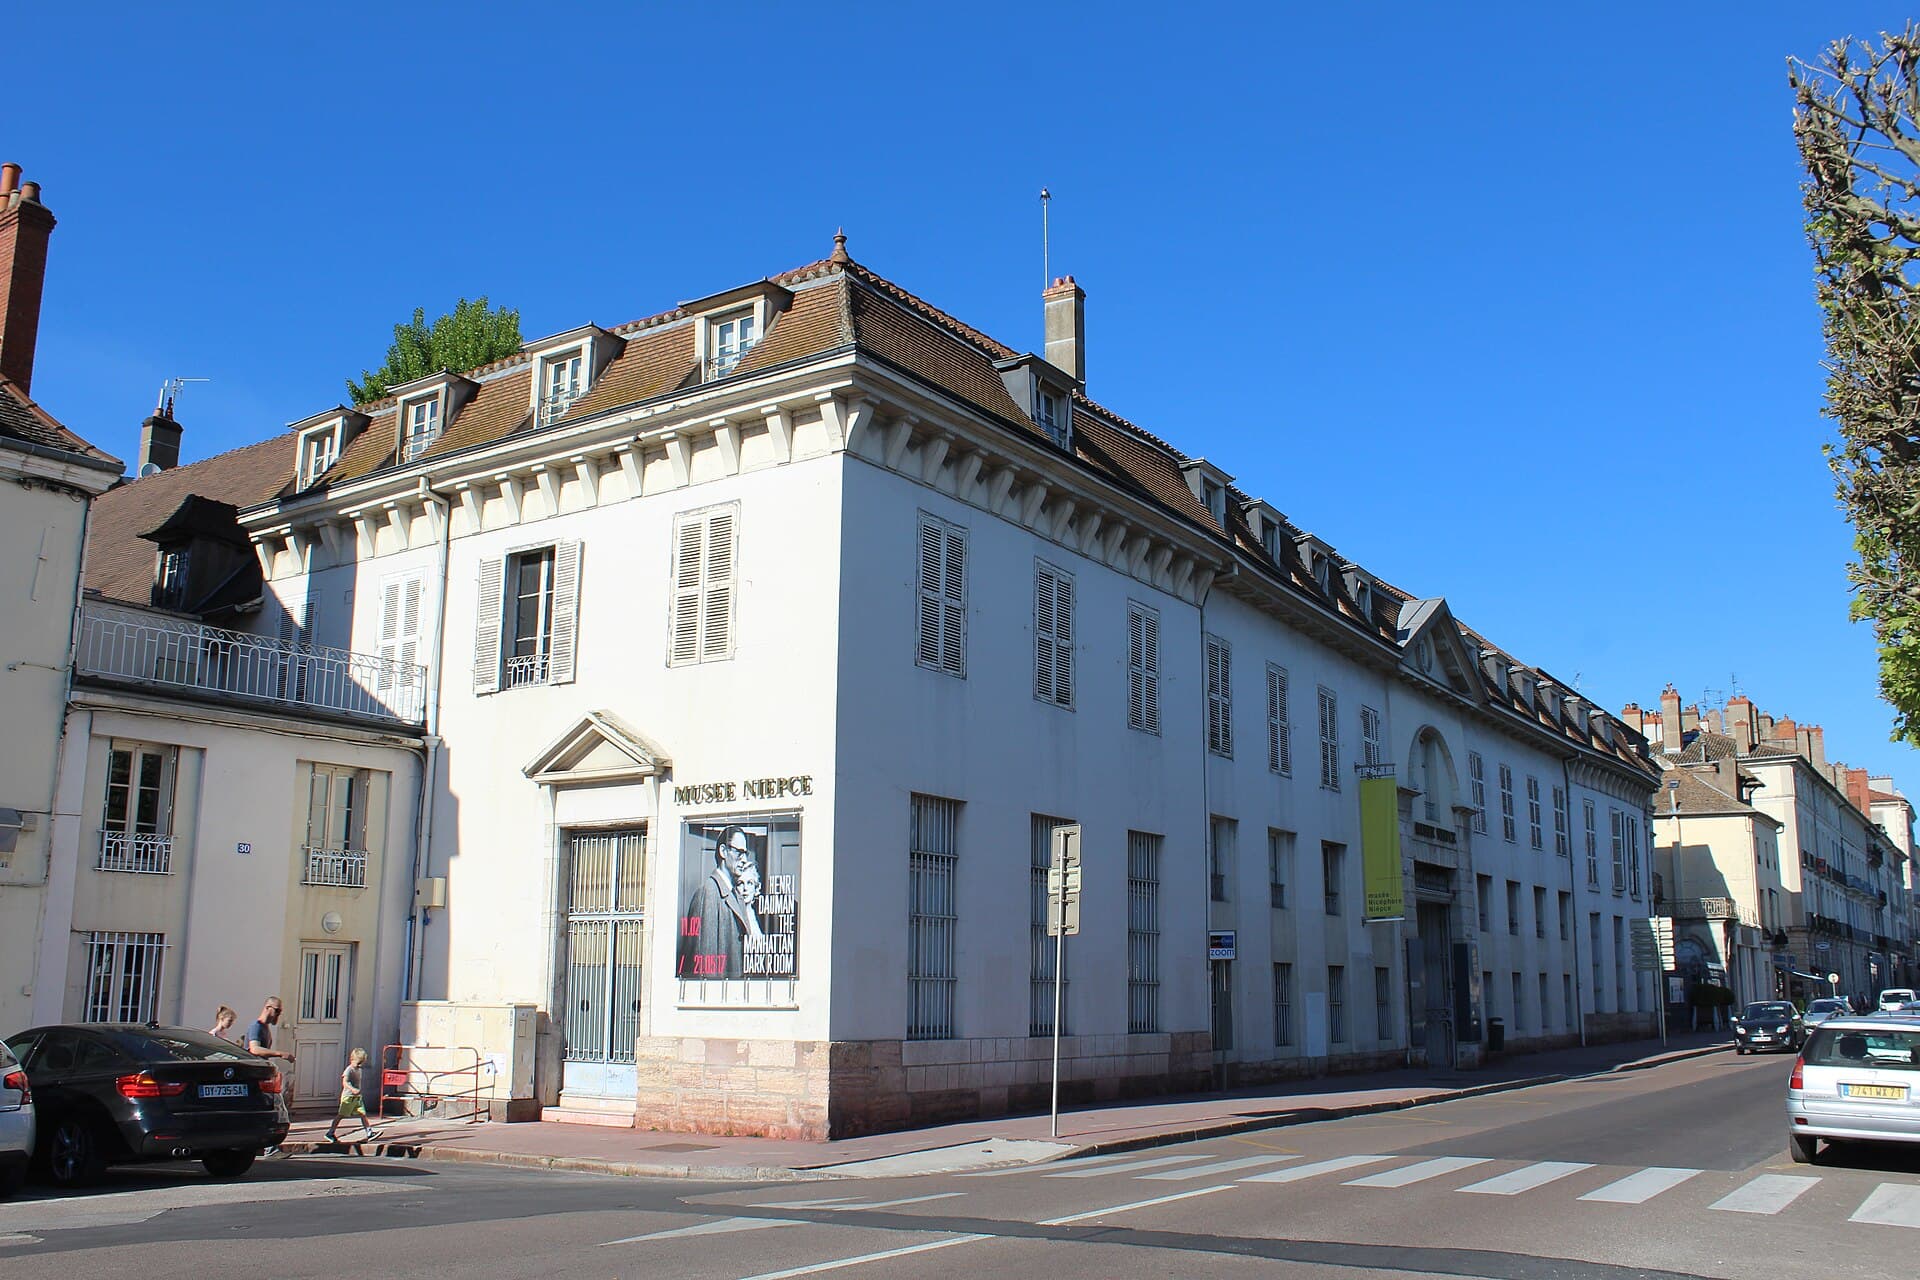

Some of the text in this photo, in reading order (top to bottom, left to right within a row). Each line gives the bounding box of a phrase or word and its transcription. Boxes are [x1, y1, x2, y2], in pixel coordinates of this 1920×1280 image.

[674, 775, 813, 806] MUSEE NIEPCE
[239, 844, 250, 853] 30
[769, 874, 795, 895] HENRI
[758, 893, 795, 915] DAUMAN
[681, 916, 701, 937] 11.02
[779, 913, 795, 934] THE
[743, 933, 794, 954] MANHATTAN
[1210, 948, 1235, 958] zoom
[693, 954, 727, 975] 21.0517
